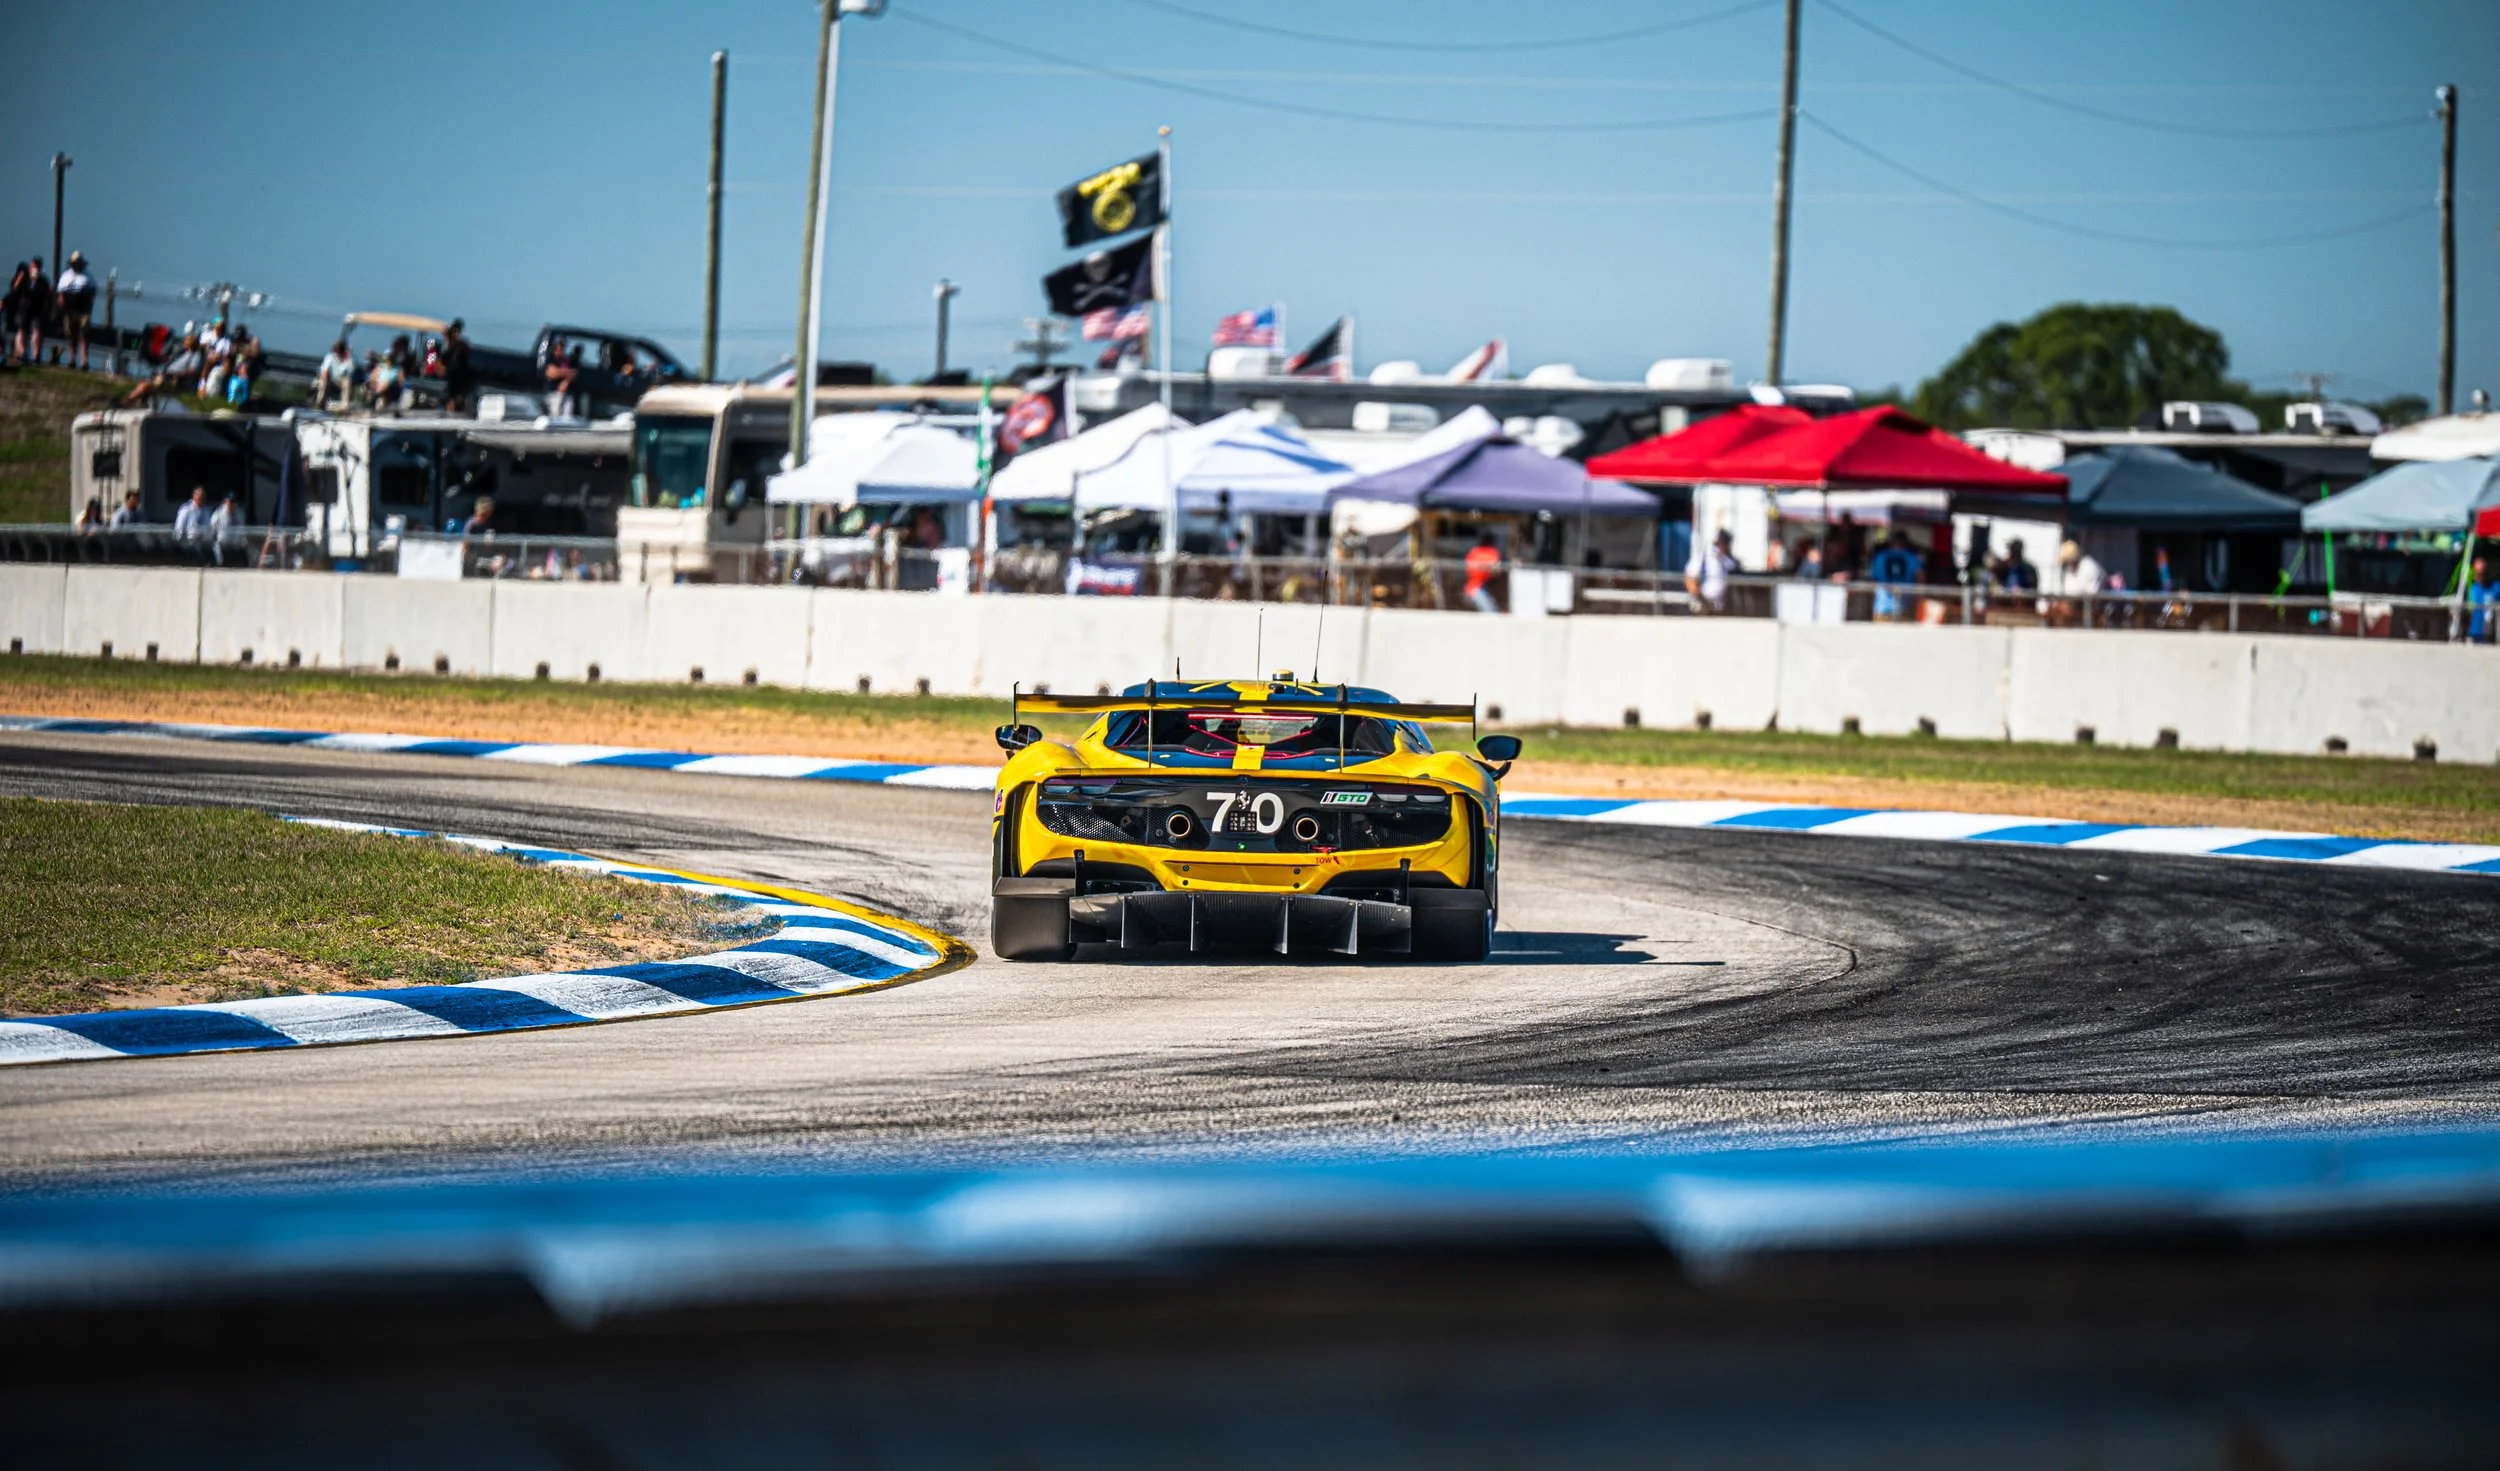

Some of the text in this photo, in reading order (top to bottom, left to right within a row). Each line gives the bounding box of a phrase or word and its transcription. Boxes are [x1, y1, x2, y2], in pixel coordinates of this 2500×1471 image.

[1337, 793, 1368, 803] GTD
[1206, 791, 1284, 834] 70
[1315, 856, 1332, 864] TOW
